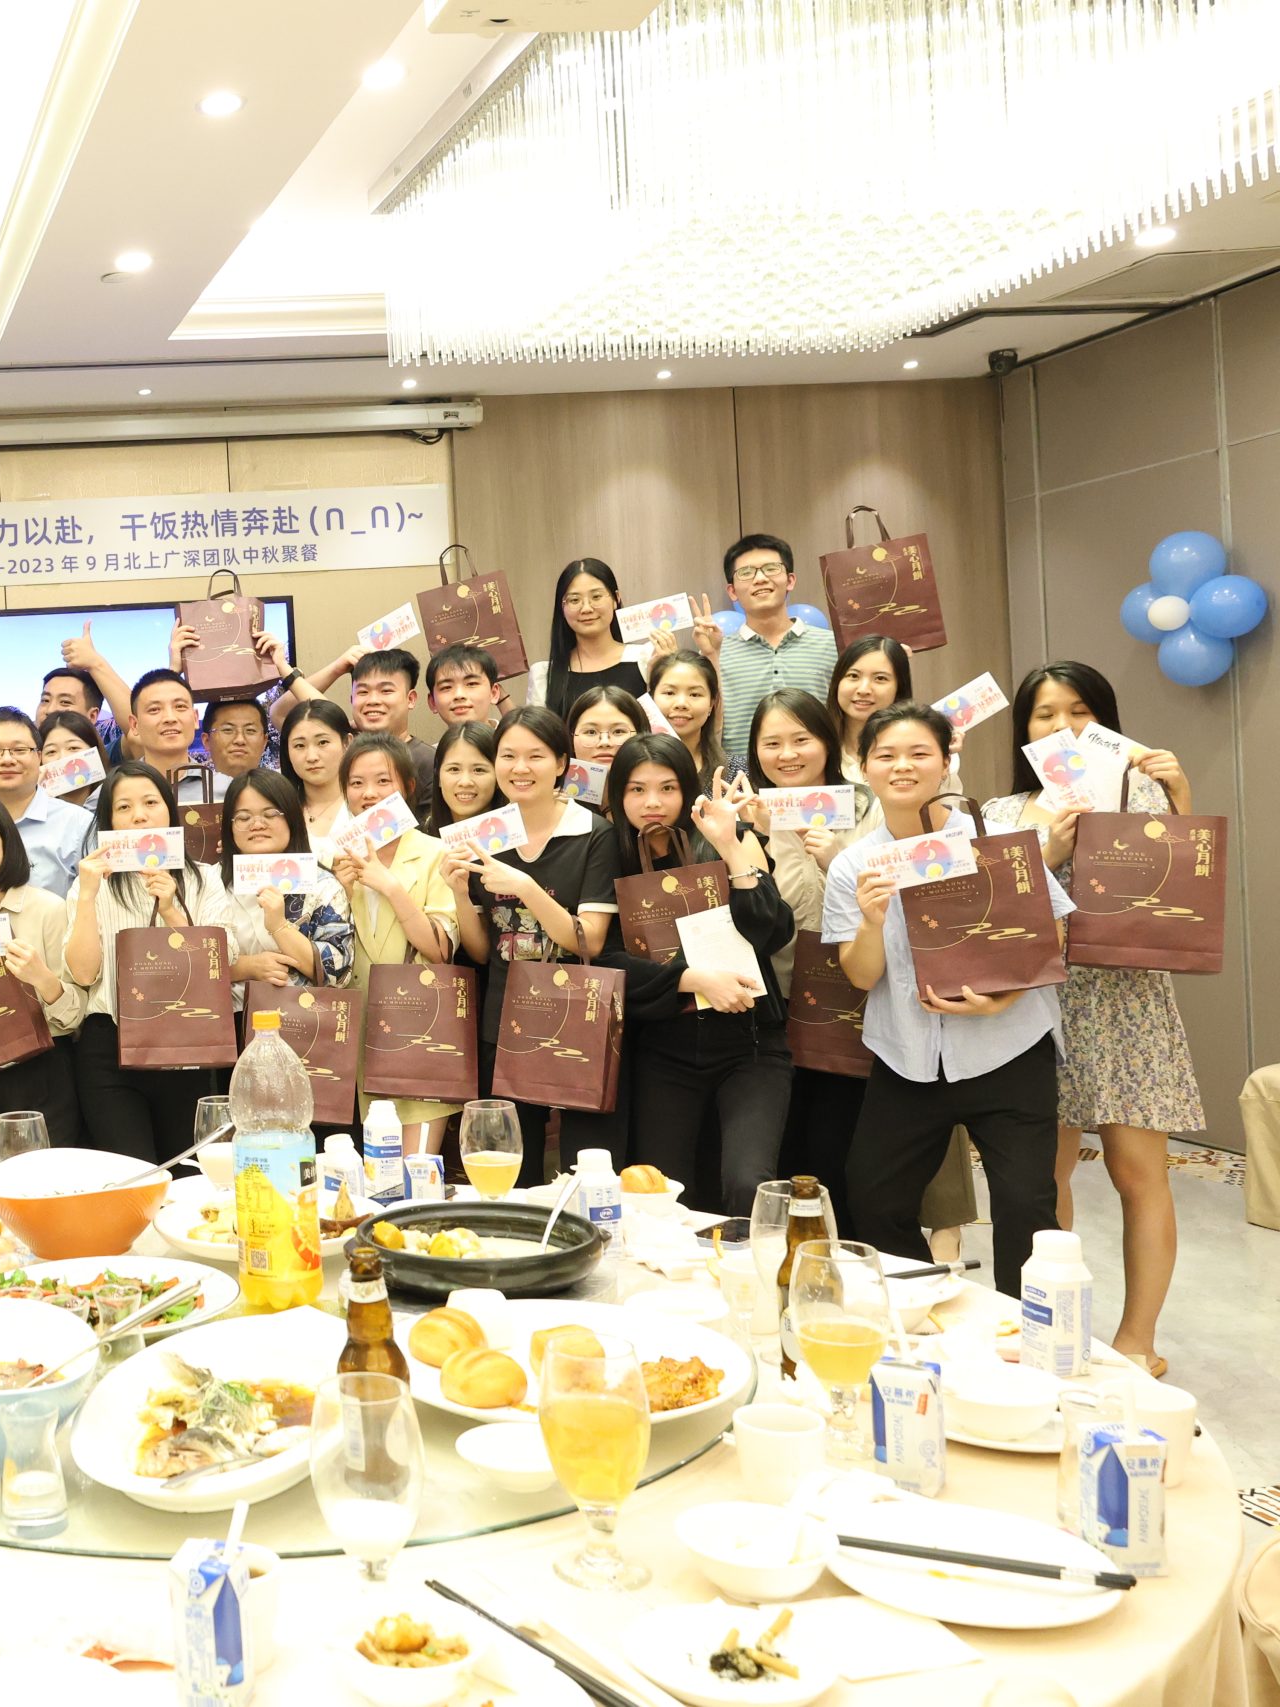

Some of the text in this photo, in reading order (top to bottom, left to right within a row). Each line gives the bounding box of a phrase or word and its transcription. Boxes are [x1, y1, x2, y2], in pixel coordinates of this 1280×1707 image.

[1195, 829, 1212, 877] 美心月餅
[703, 875, 719, 908] 美心月
